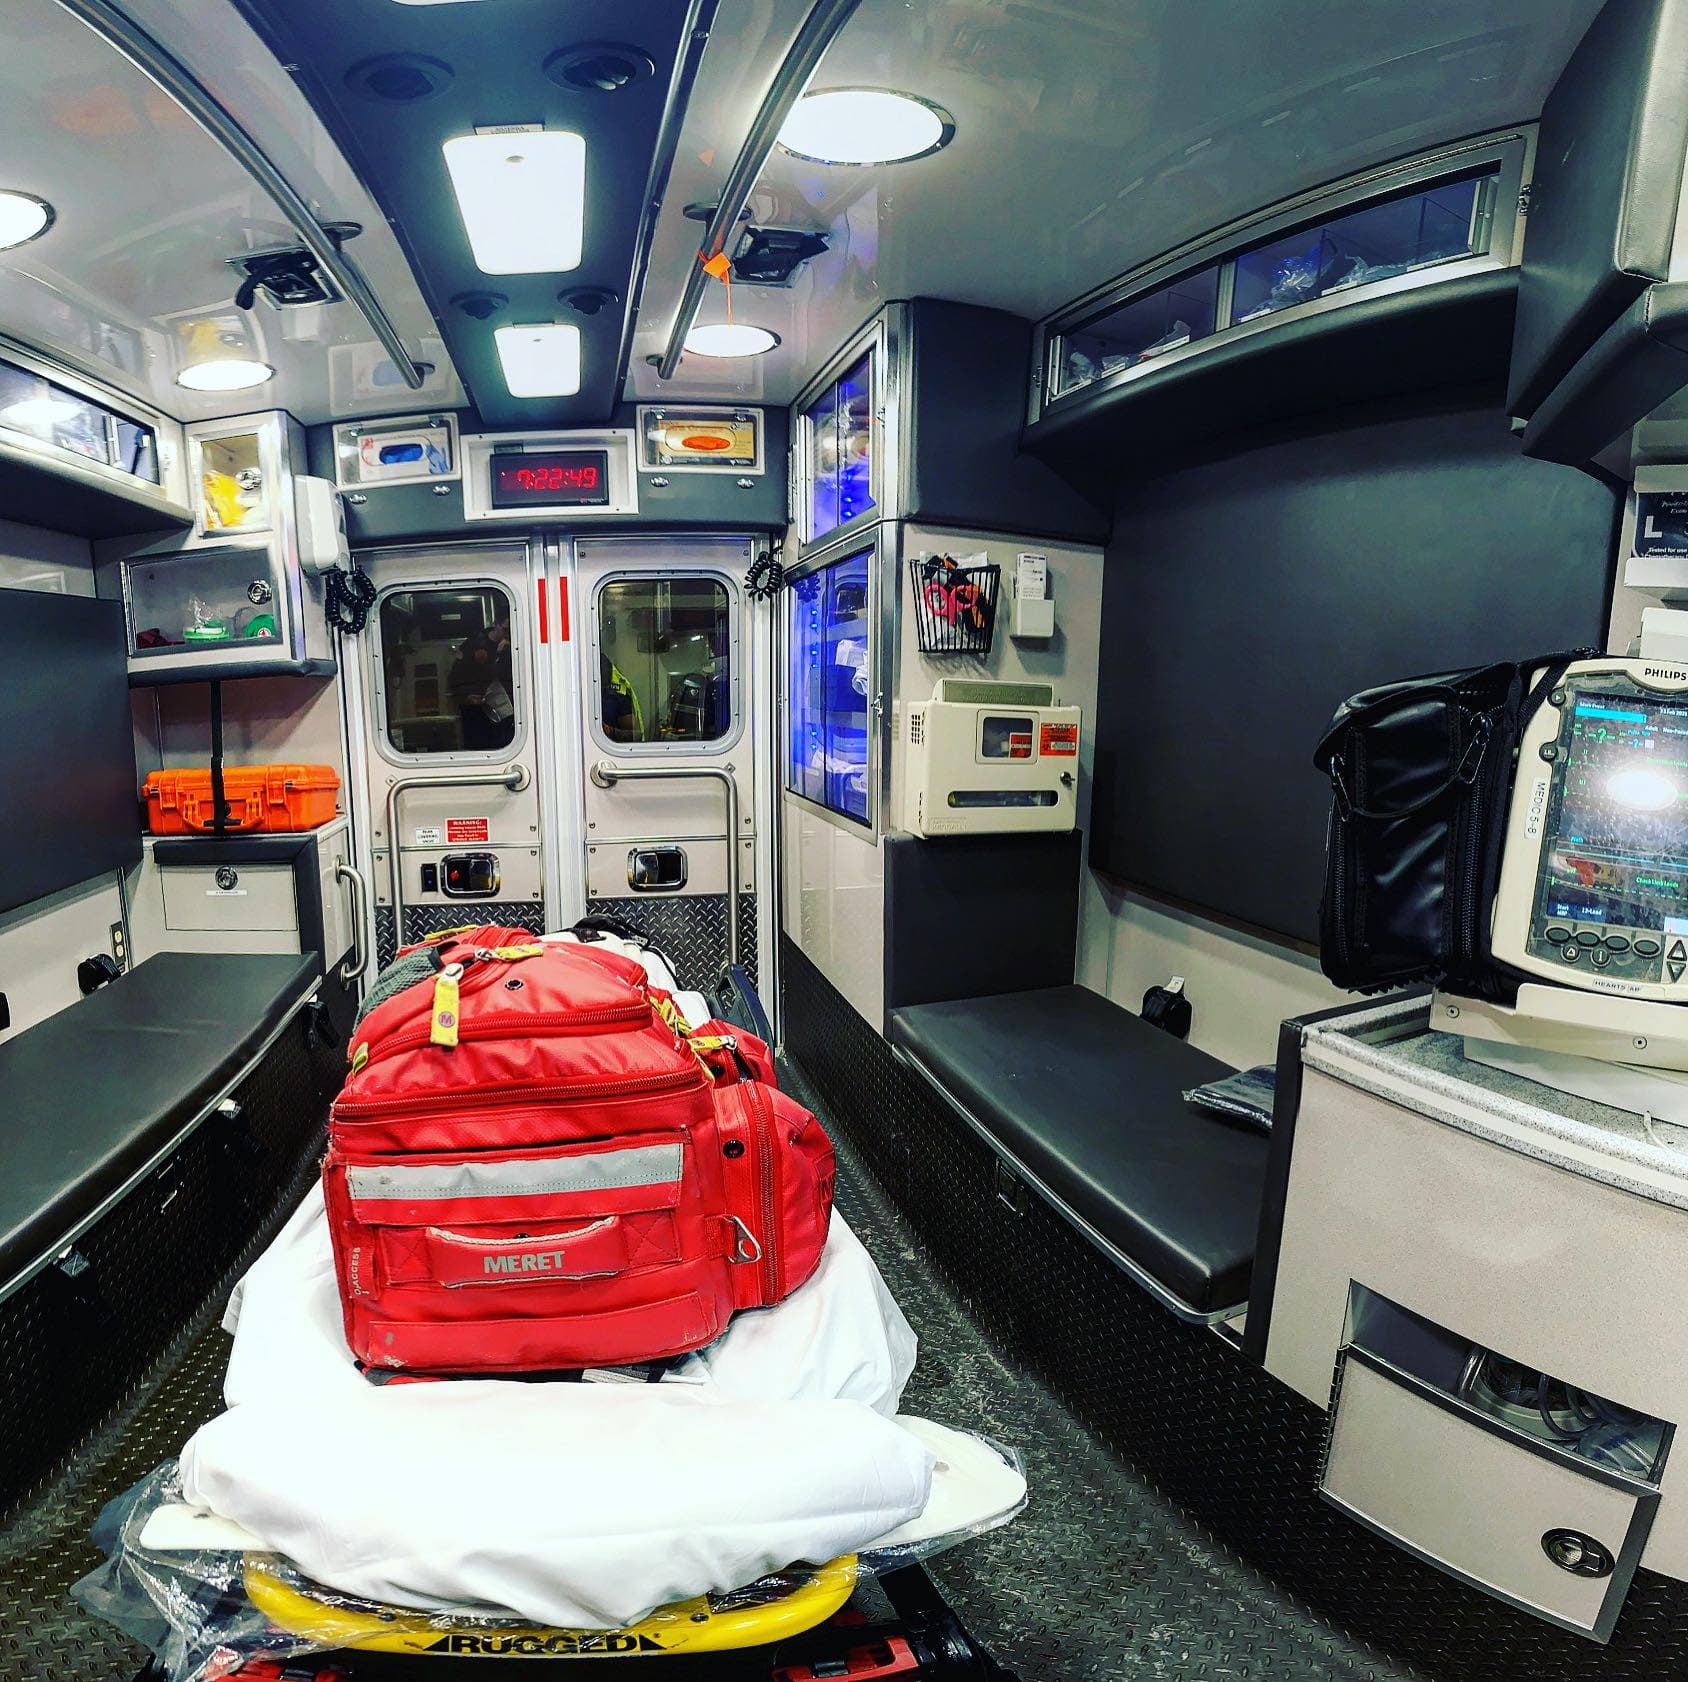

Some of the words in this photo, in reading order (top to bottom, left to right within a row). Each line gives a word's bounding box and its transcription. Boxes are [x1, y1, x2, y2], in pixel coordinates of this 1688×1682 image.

[1644, 515, 1662, 538] L
[1644, 668, 1687, 681] PHILIPS
[1531, 782, 1546, 815] MEDIC
[484, 1250, 565, 1274] MERET
[450, 1634, 637, 1654] RUGGED
